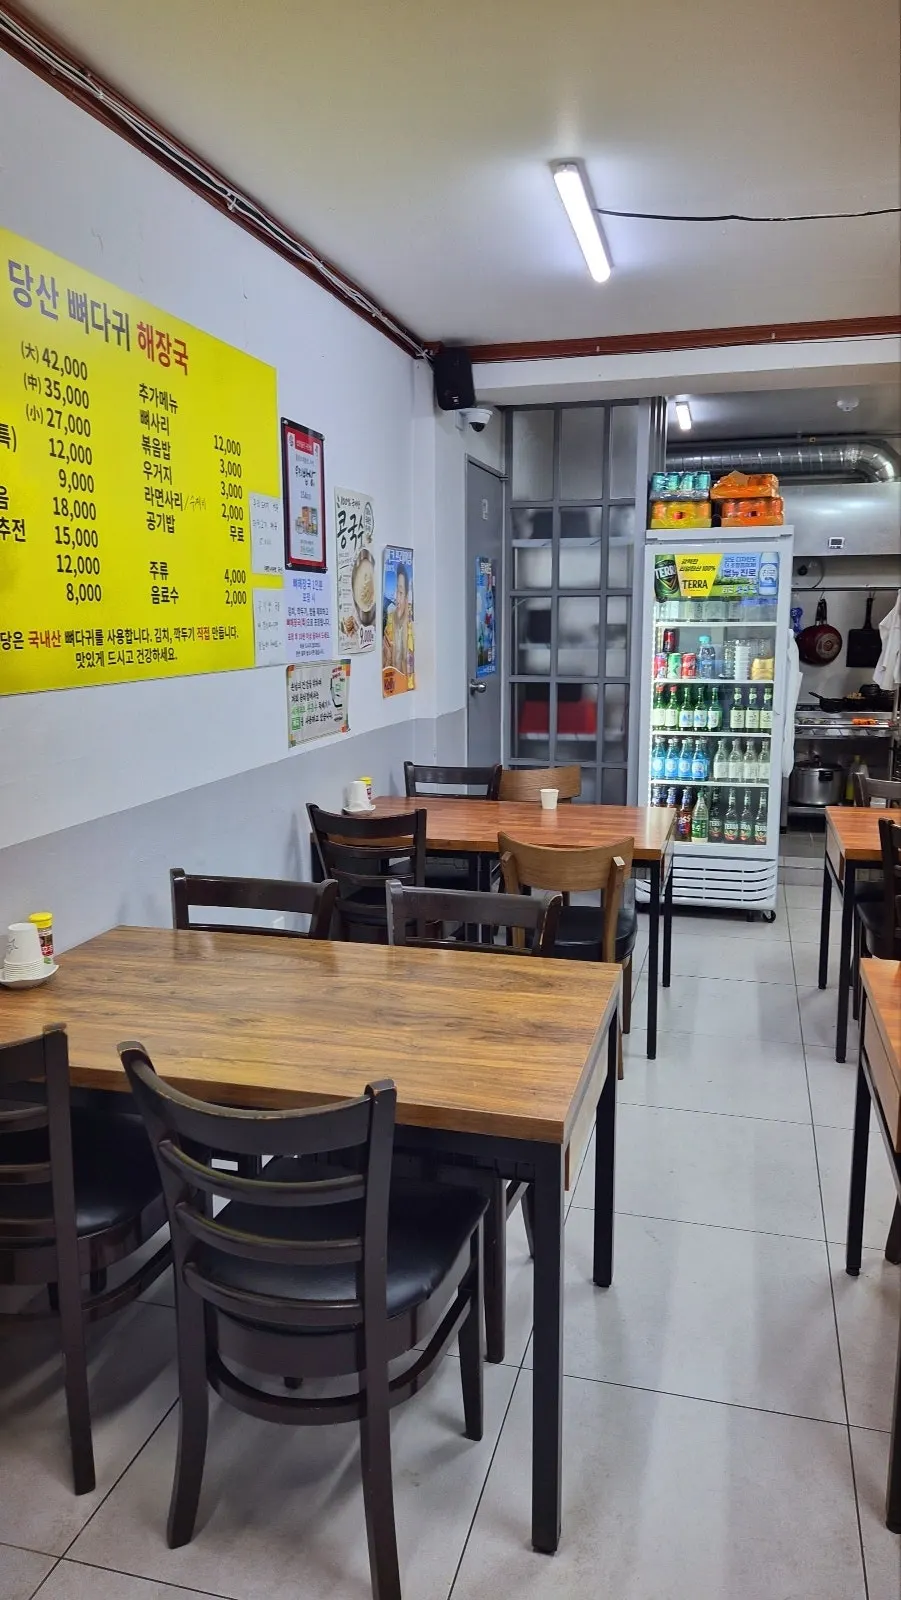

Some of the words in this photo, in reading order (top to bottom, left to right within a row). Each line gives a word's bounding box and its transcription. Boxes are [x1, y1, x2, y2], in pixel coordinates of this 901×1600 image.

[8, 259, 59, 320] 당산
[67, 288, 131, 352] 뼈다귀
[136, 320, 189, 376] 해장국
[42, 347, 88, 381] 42,000
[23, 372, 42, 395] (中)
[44, 377, 89, 410] 35,000
[138, 382, 179, 415] 추가메뉴
[46, 408, 91, 437] 27,000
[48, 437, 93, 465] 12,000
[141, 434, 171, 461] 볶음밥
[219, 458, 242, 479] 3,000
[214, 434, 241, 457] 12,000
[58, 468, 94, 494] 9,000
[143, 460, 173, 486] 우거지
[220, 481, 243, 500] 3,000
[52, 496, 97, 521] 18,000
[144, 486, 183, 512] 라면사리
[221, 503, 244, 522] 2,000
[55, 526, 99, 549] 15,000
[146, 511, 176, 534] 공기밥
[229, 525, 245, 543] 무료
[337, 510, 364, 551] 콩국수
[56, 554, 100, 576] 12,000
[149, 561, 169, 581] 주류
[224, 569, 246, 586] 4,000
[66, 583, 102, 605] 8,000
[150, 586, 179, 606] 음료수
[225, 590, 247, 607] 2,000
[682, 579, 709, 589] TERRA
[28, 629, 61, 648] 국내산
[64, 628, 104, 647] 뼈다귀를
[107, 627, 152, 645] 사용합니다.
[154, 628, 173, 645] 김치,
[173, 626, 195, 642] 깍두기
[196, 626, 210, 641] 직접
[211, 625, 239, 640] 만듭니다.
[75, 650, 105, 669] 맛있게
[108, 648, 134, 666] 드시고
[136, 647, 178, 665] 건강하세요.
